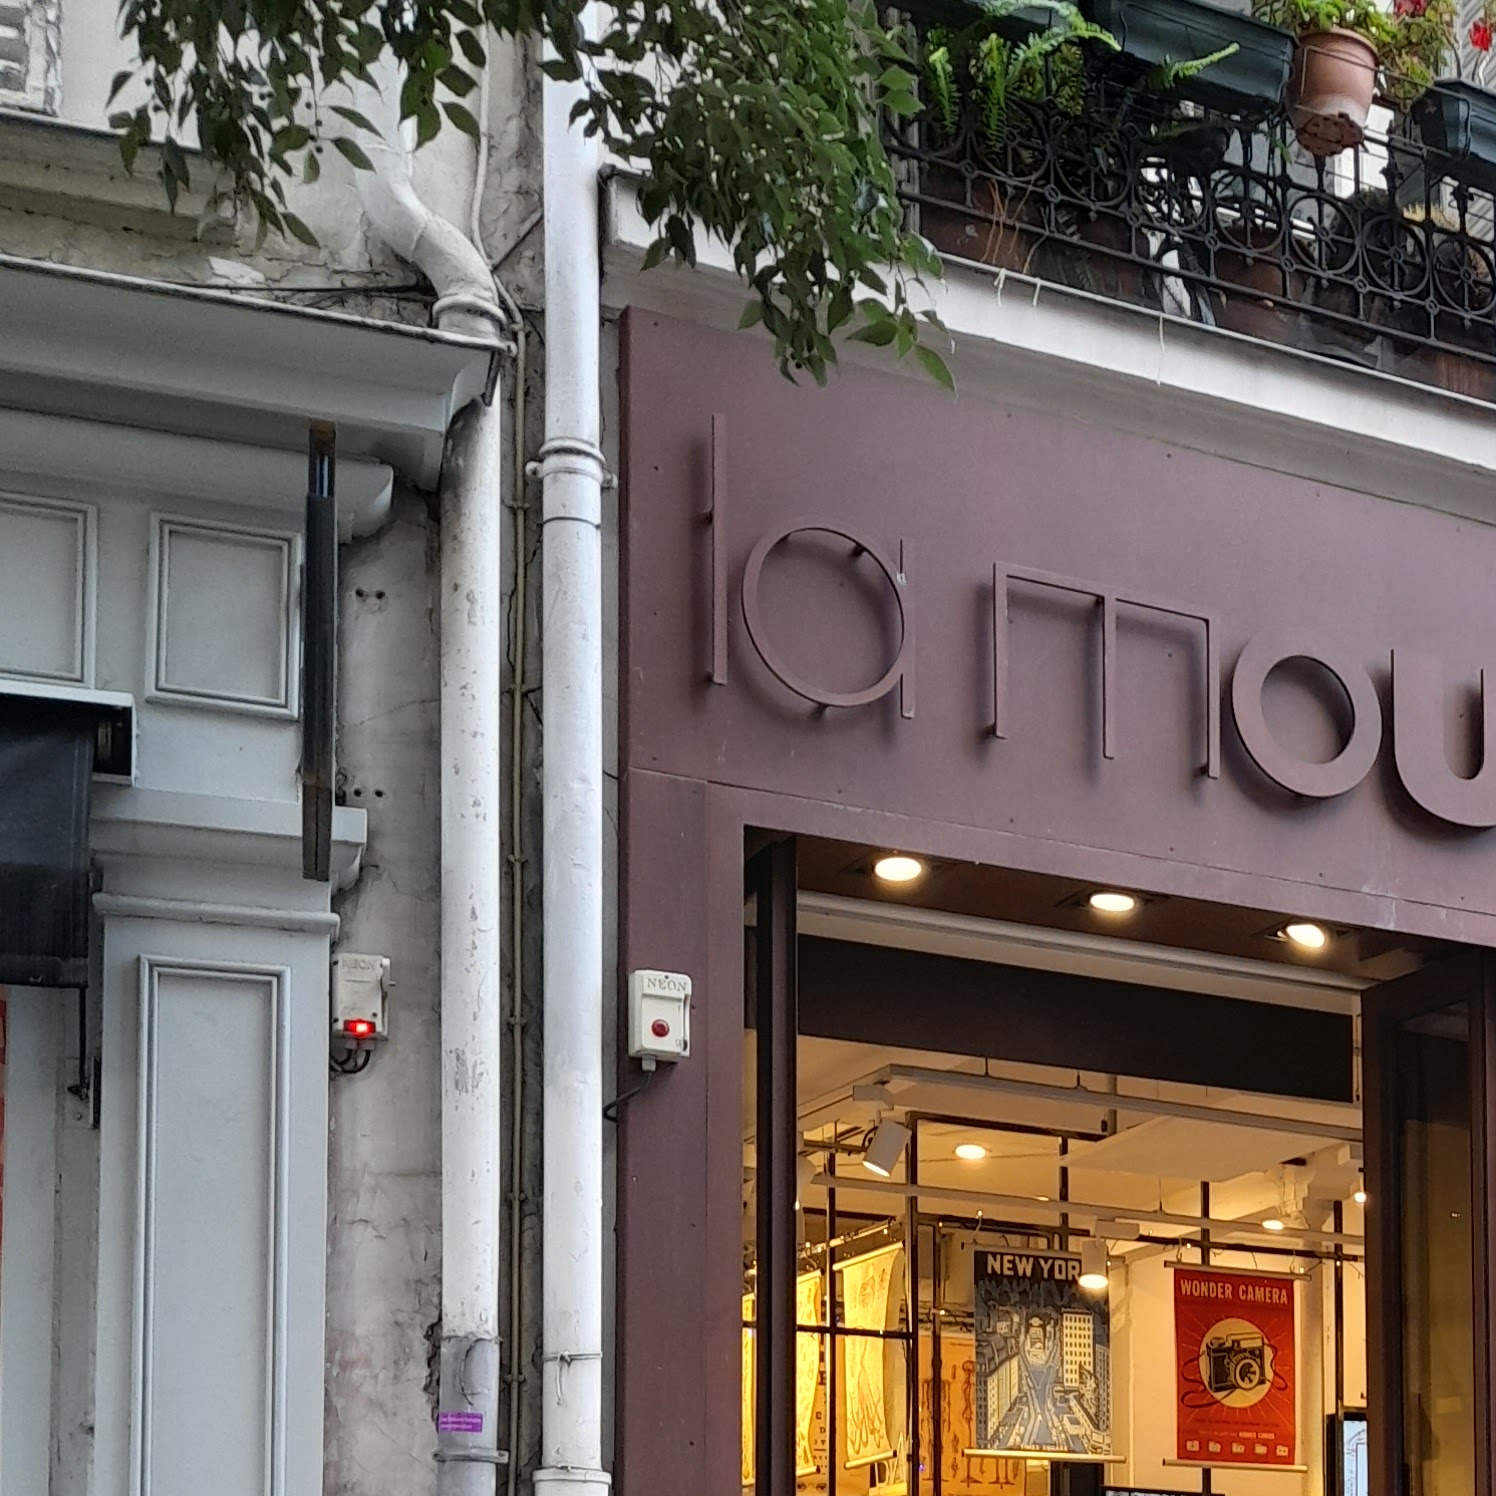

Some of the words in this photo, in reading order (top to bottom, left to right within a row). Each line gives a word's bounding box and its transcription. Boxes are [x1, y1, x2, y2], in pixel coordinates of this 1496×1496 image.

[711, 413, 915, 720] la
[646, 976, 688, 993] NEON
[986, 1253, 1034, 1278] NEW
[1037, 1257, 1081, 1281] YOR
[1180, 1278, 1233, 1299] WONDER
[1238, 1284, 1289, 1305] CAMERA
